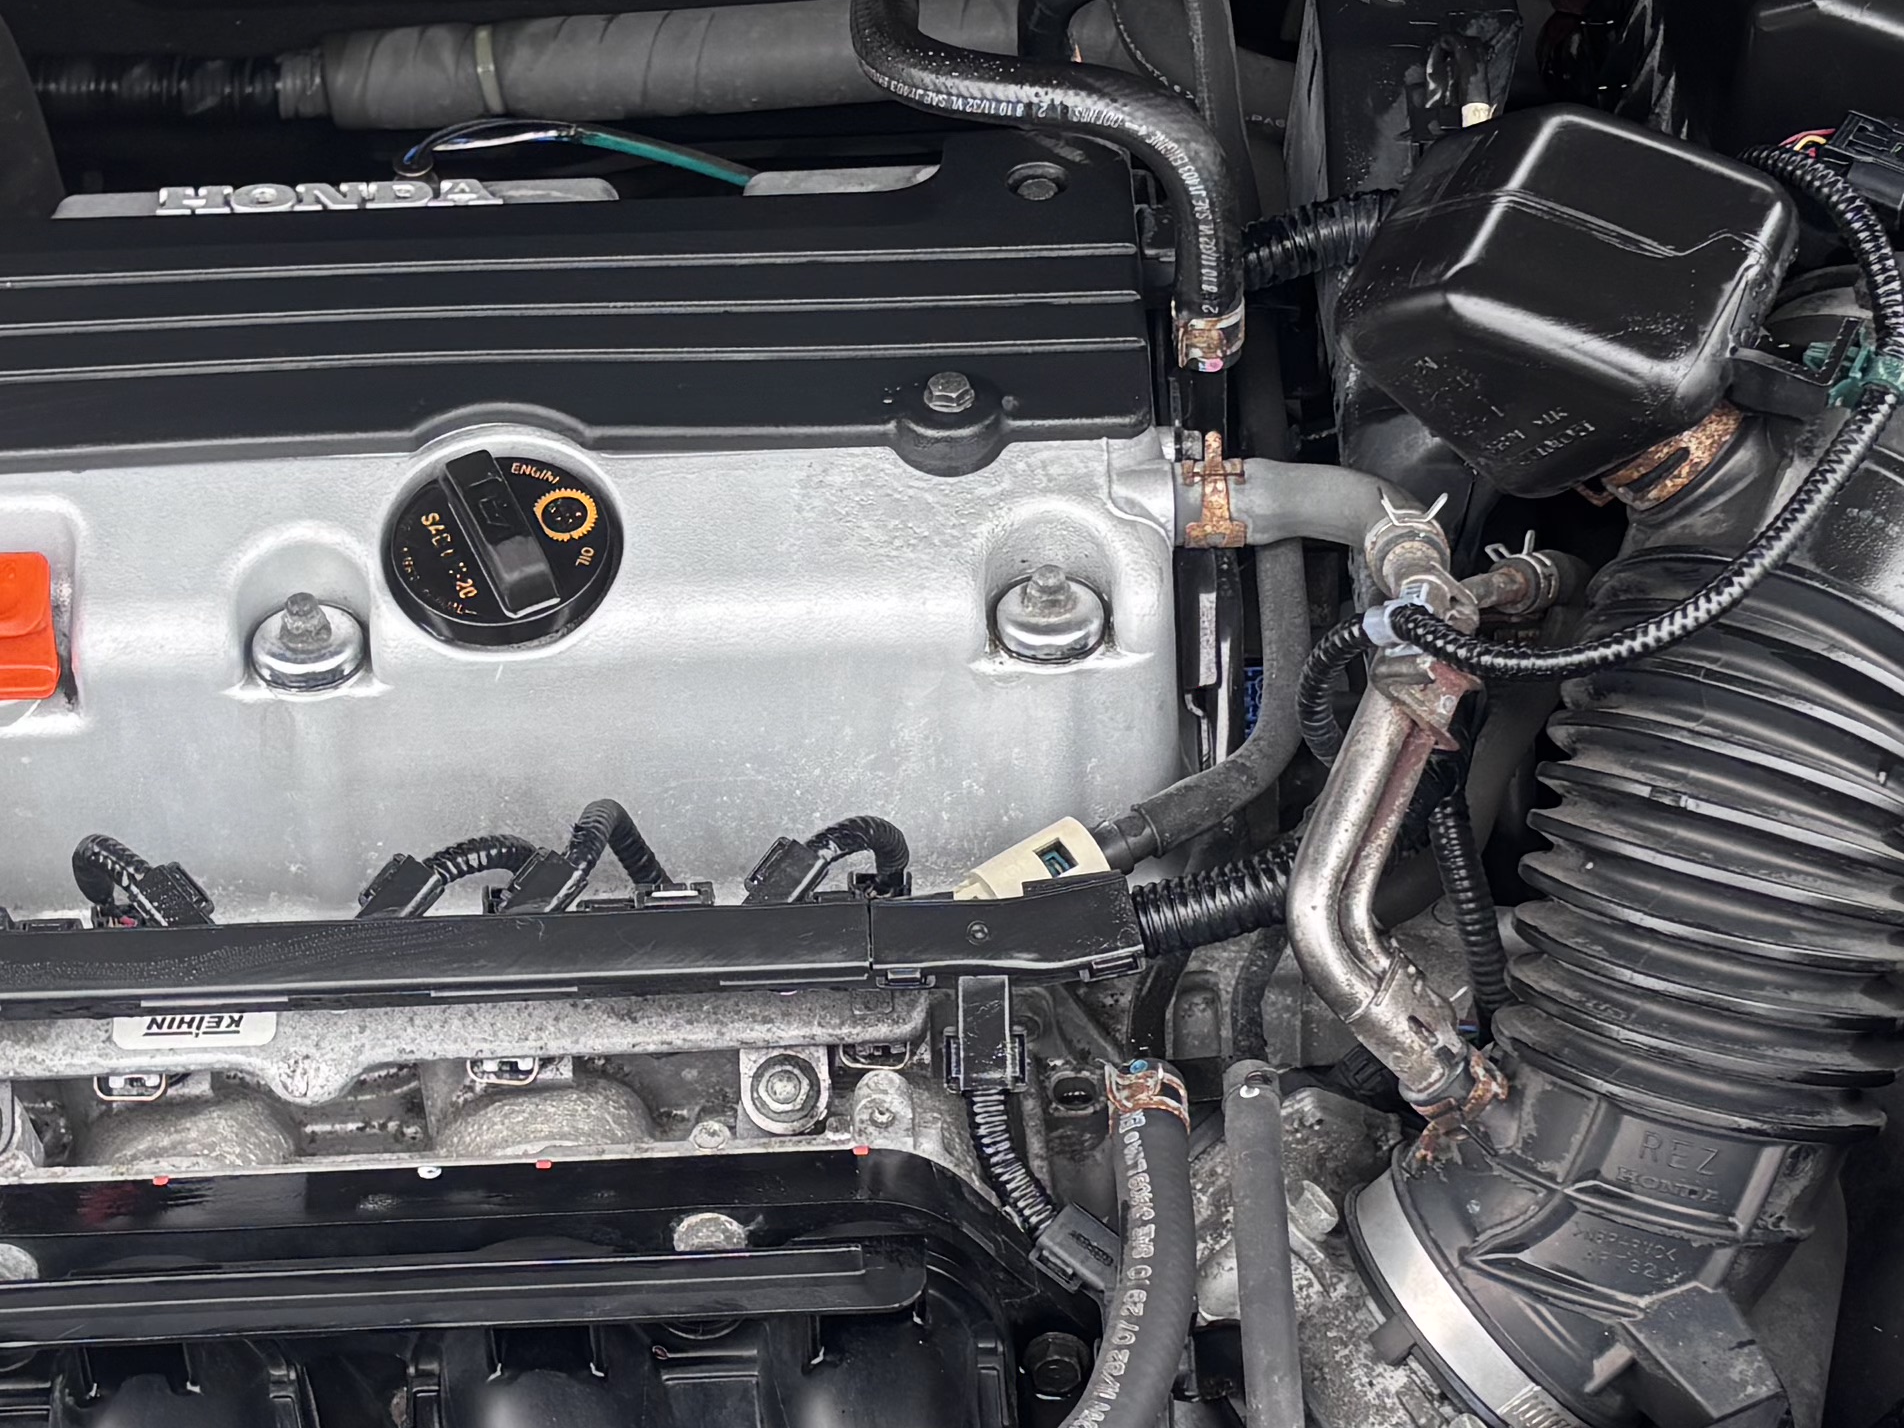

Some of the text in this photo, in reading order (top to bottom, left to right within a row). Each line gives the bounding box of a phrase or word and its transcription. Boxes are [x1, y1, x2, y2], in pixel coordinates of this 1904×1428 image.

[155, 178, 504, 215] HONDA
[575, 546, 594, 567] OIL
[1638, 1130, 1718, 1176] REZ
[1131, 1223, 1155, 1258] SAE
